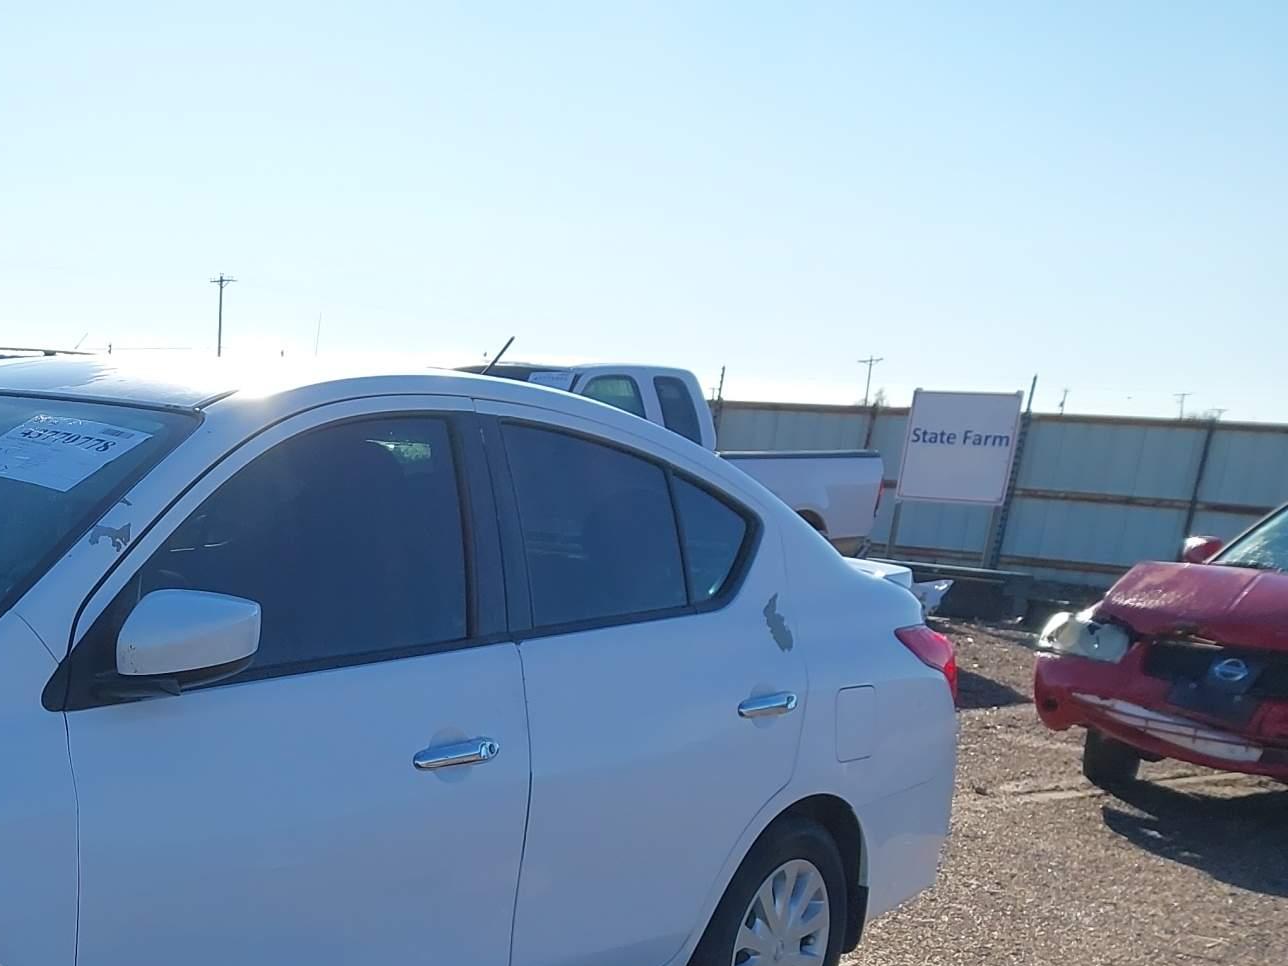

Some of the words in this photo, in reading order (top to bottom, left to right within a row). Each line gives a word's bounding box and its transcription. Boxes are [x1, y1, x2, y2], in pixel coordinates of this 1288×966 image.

[21, 428, 117, 453] 43770778
[911, 427, 957, 445] State
[962, 430, 1011, 447] Farm
